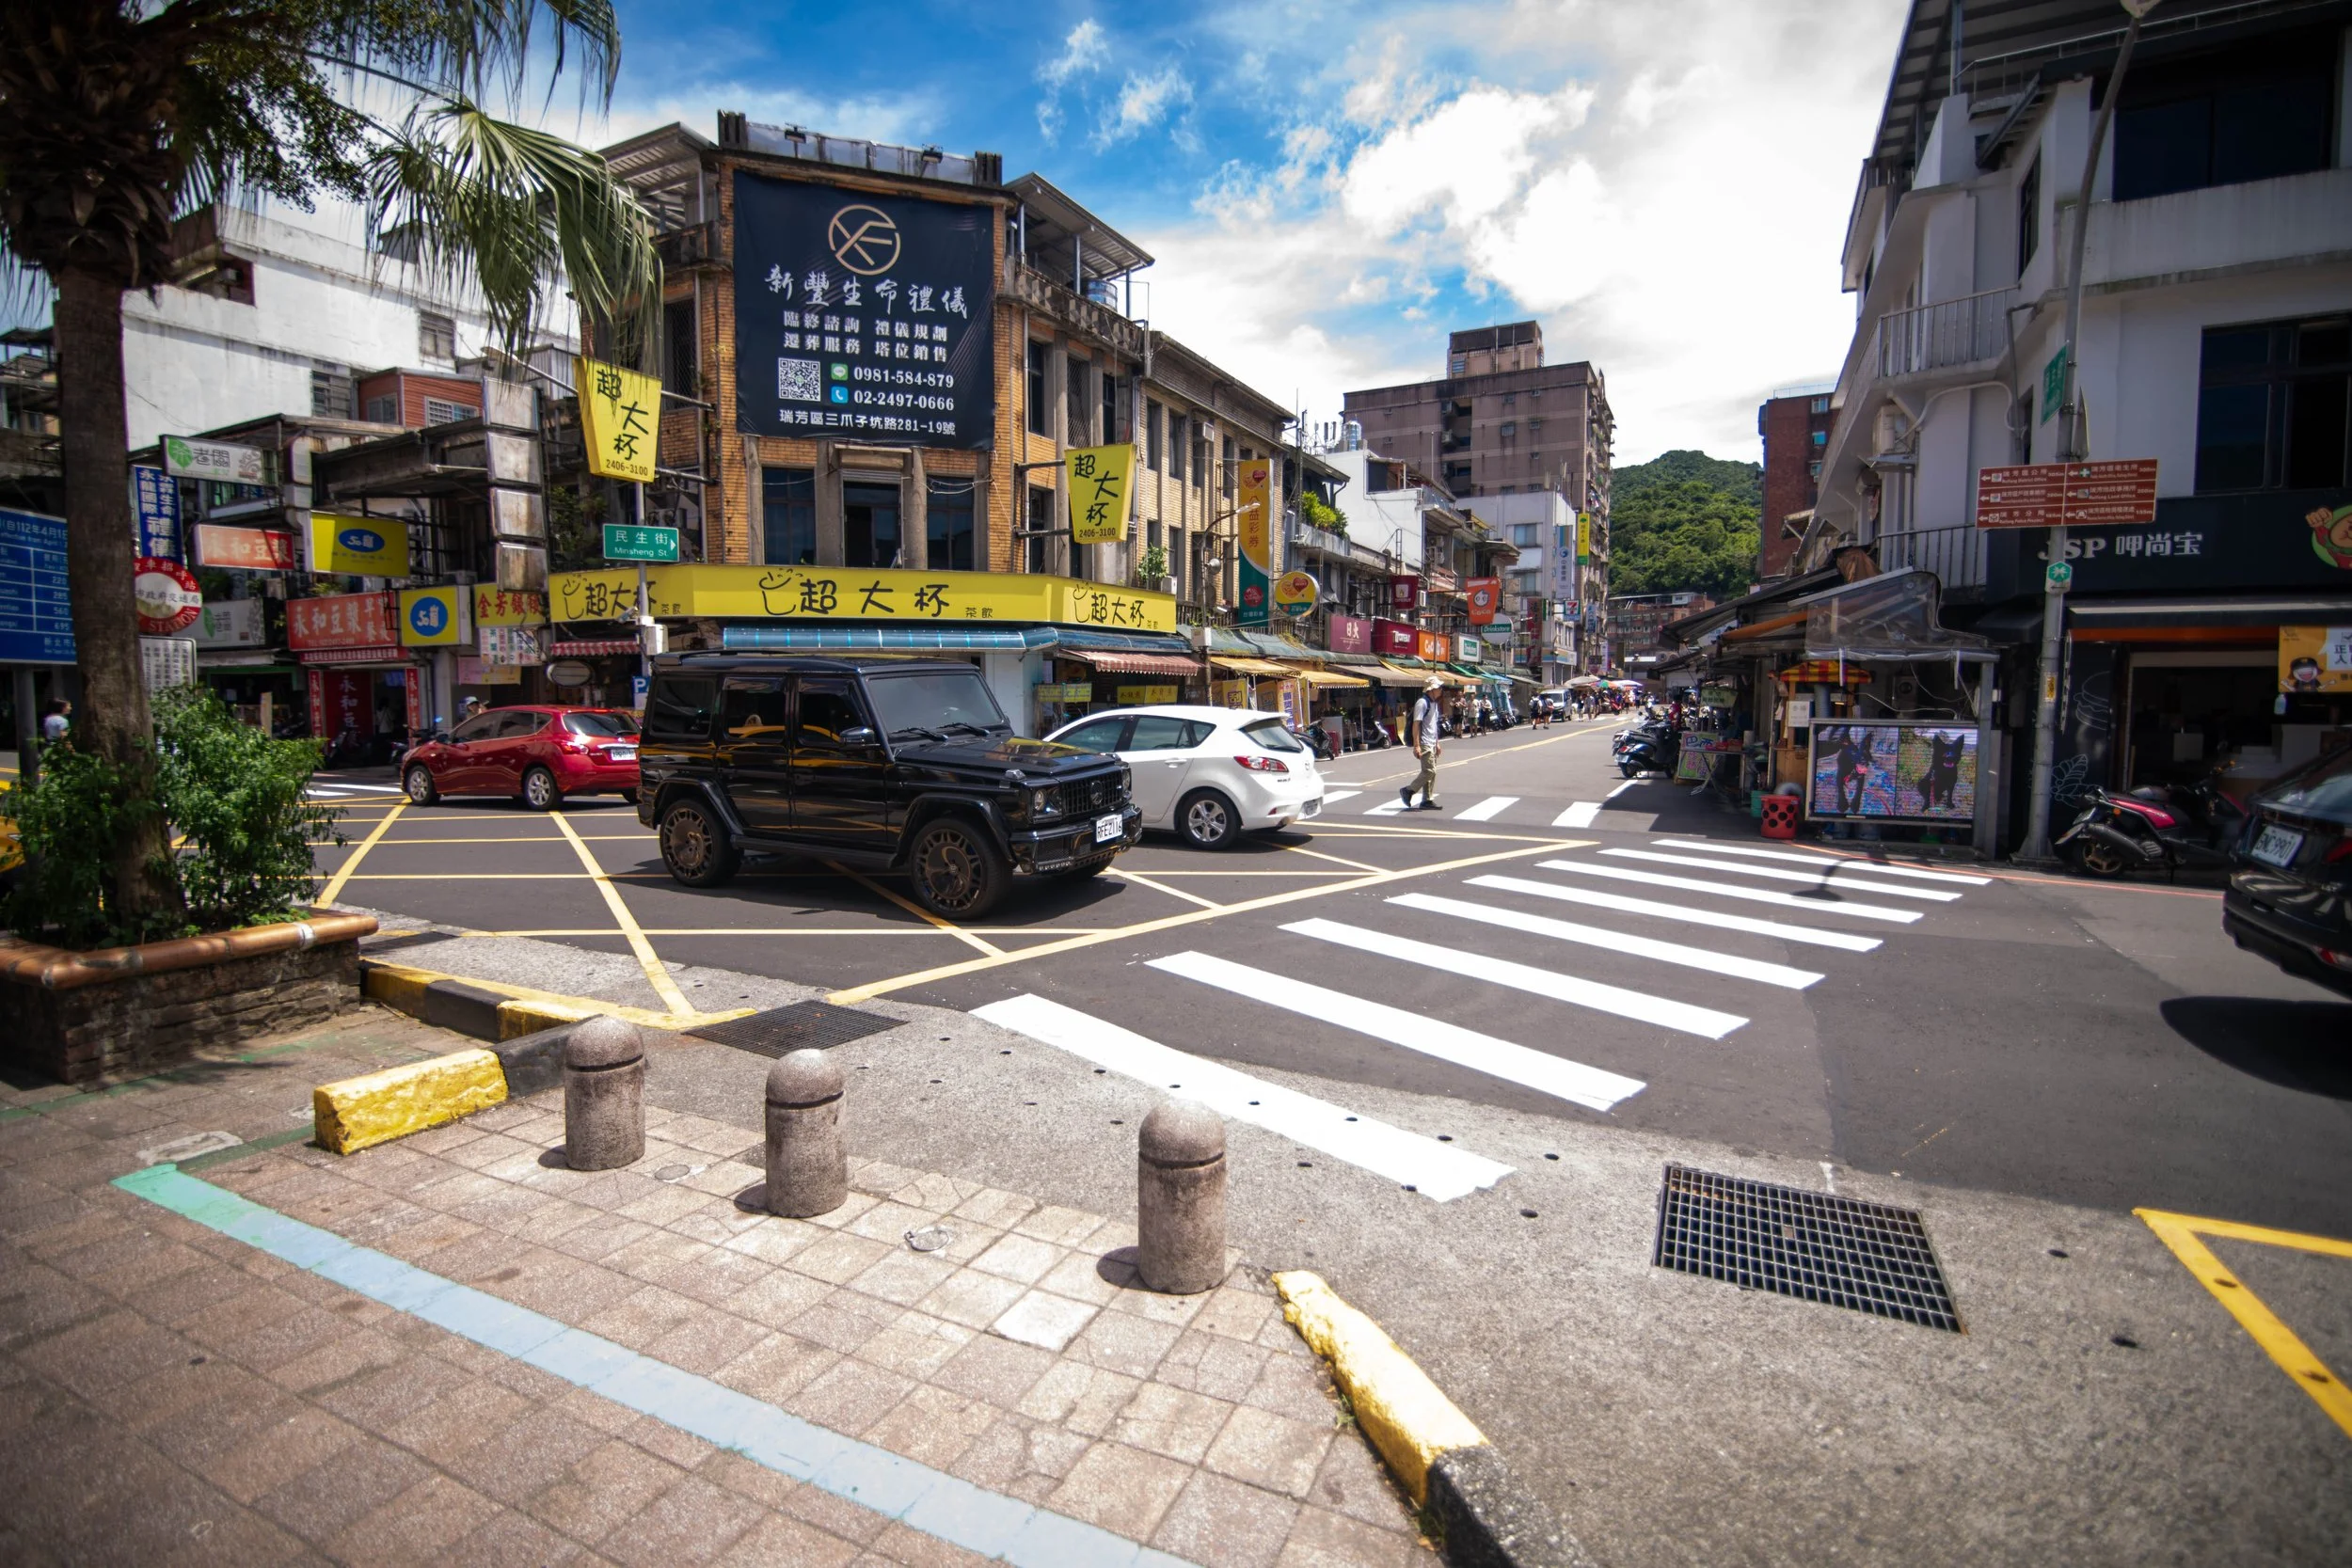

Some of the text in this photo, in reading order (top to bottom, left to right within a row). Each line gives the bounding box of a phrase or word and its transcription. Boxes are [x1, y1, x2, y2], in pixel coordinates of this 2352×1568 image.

[765, 263, 968, 320] 新豐生命禮儀
[784, 310, 947, 342] 臨終諮詢 禮儀規劃
[875, 341, 947, 363] 塔位銷售
[853, 367, 954, 388] 0981-584-879
[596, 368, 649, 461] 超大杯
[853, 390, 954, 411] 02-2497-0666
[779, 409, 956, 436] 瑞芳區三爪子坑路281-19號
[606, 459, 648, 476] 2406-3100
[1074, 454, 1119, 527] 超大杯
[614, 530, 669, 546] 民生街
[1079, 527, 1116, 538] 2406-3100
[204, 532, 292, 563] 永和豆漿
[614, 546, 655, 558] Minsheng
[800, 578, 950, 617] 超大杯
[1090, 592, 1145, 627] 超大杯
[294, 601, 361, 639] 永和豆漿
